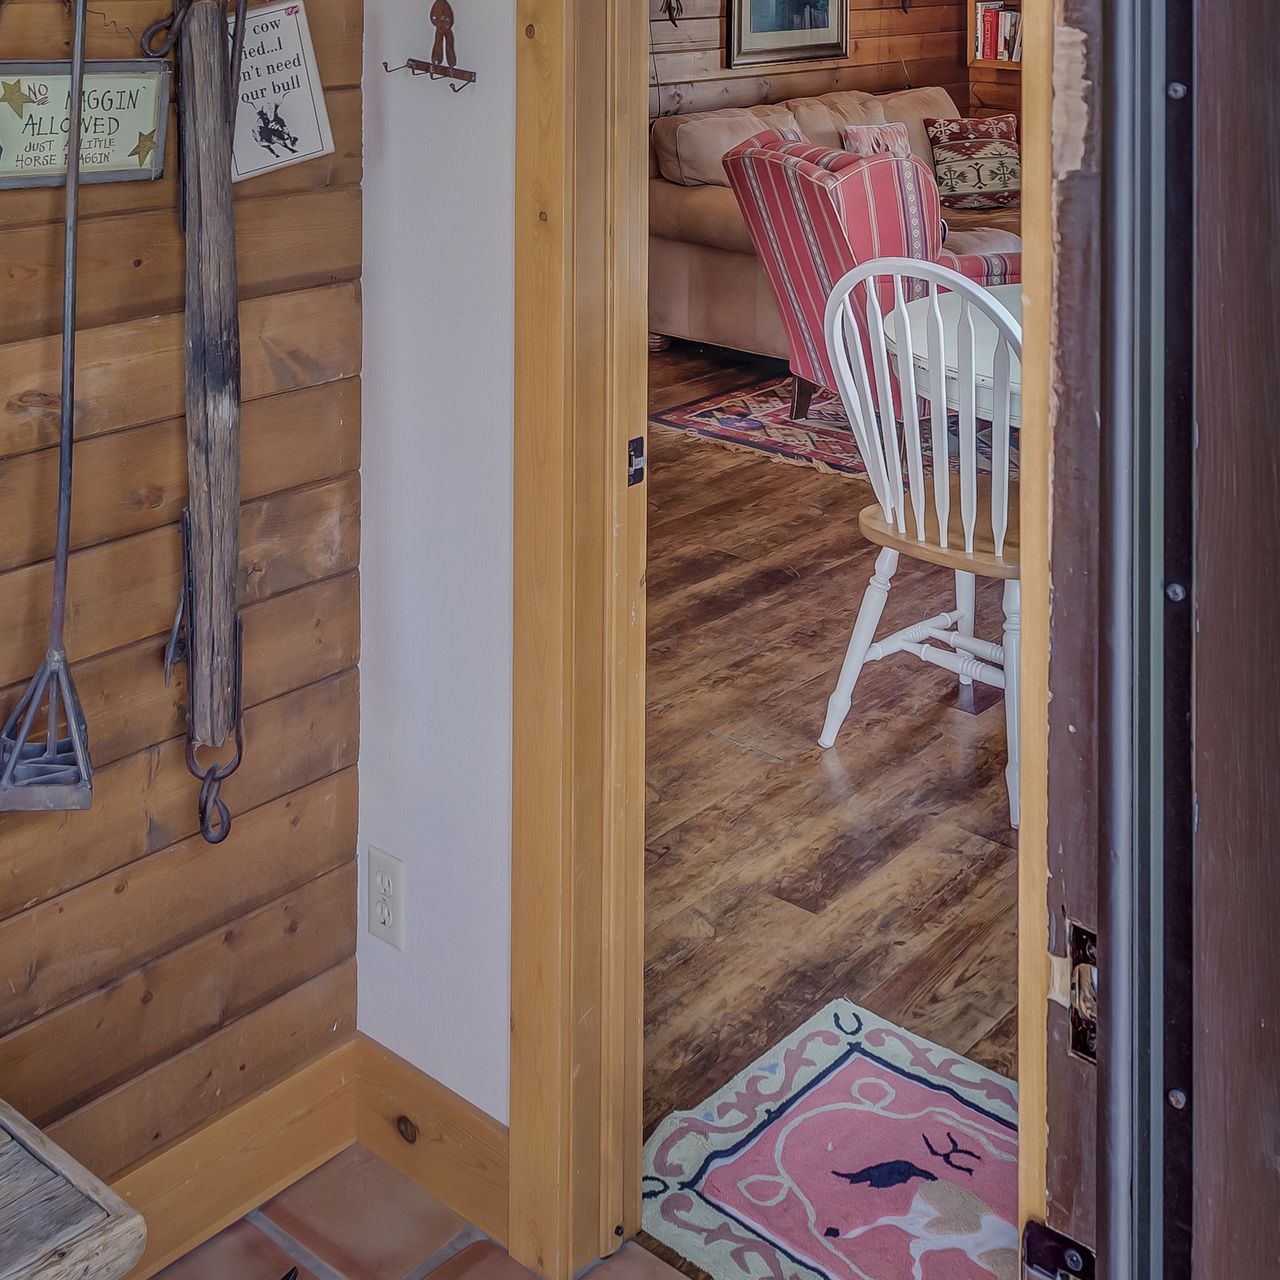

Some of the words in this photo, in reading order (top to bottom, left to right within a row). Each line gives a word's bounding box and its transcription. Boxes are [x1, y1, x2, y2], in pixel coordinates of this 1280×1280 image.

[252, 19, 282, 36] cow
[240, 36, 284, 62] ied...I
[239, 64, 262, 82] n't
[265, 52, 303, 76] need
[27, 82, 49, 100] NO
[240, 86, 268, 104] our
[270, 73, 302, 95] bull
[21, 113, 120, 137] ALLOWED
[23, 139, 56, 153] JUST
[79, 137, 117, 150] LITTLE
[14, 153, 58, 169] HORSE
